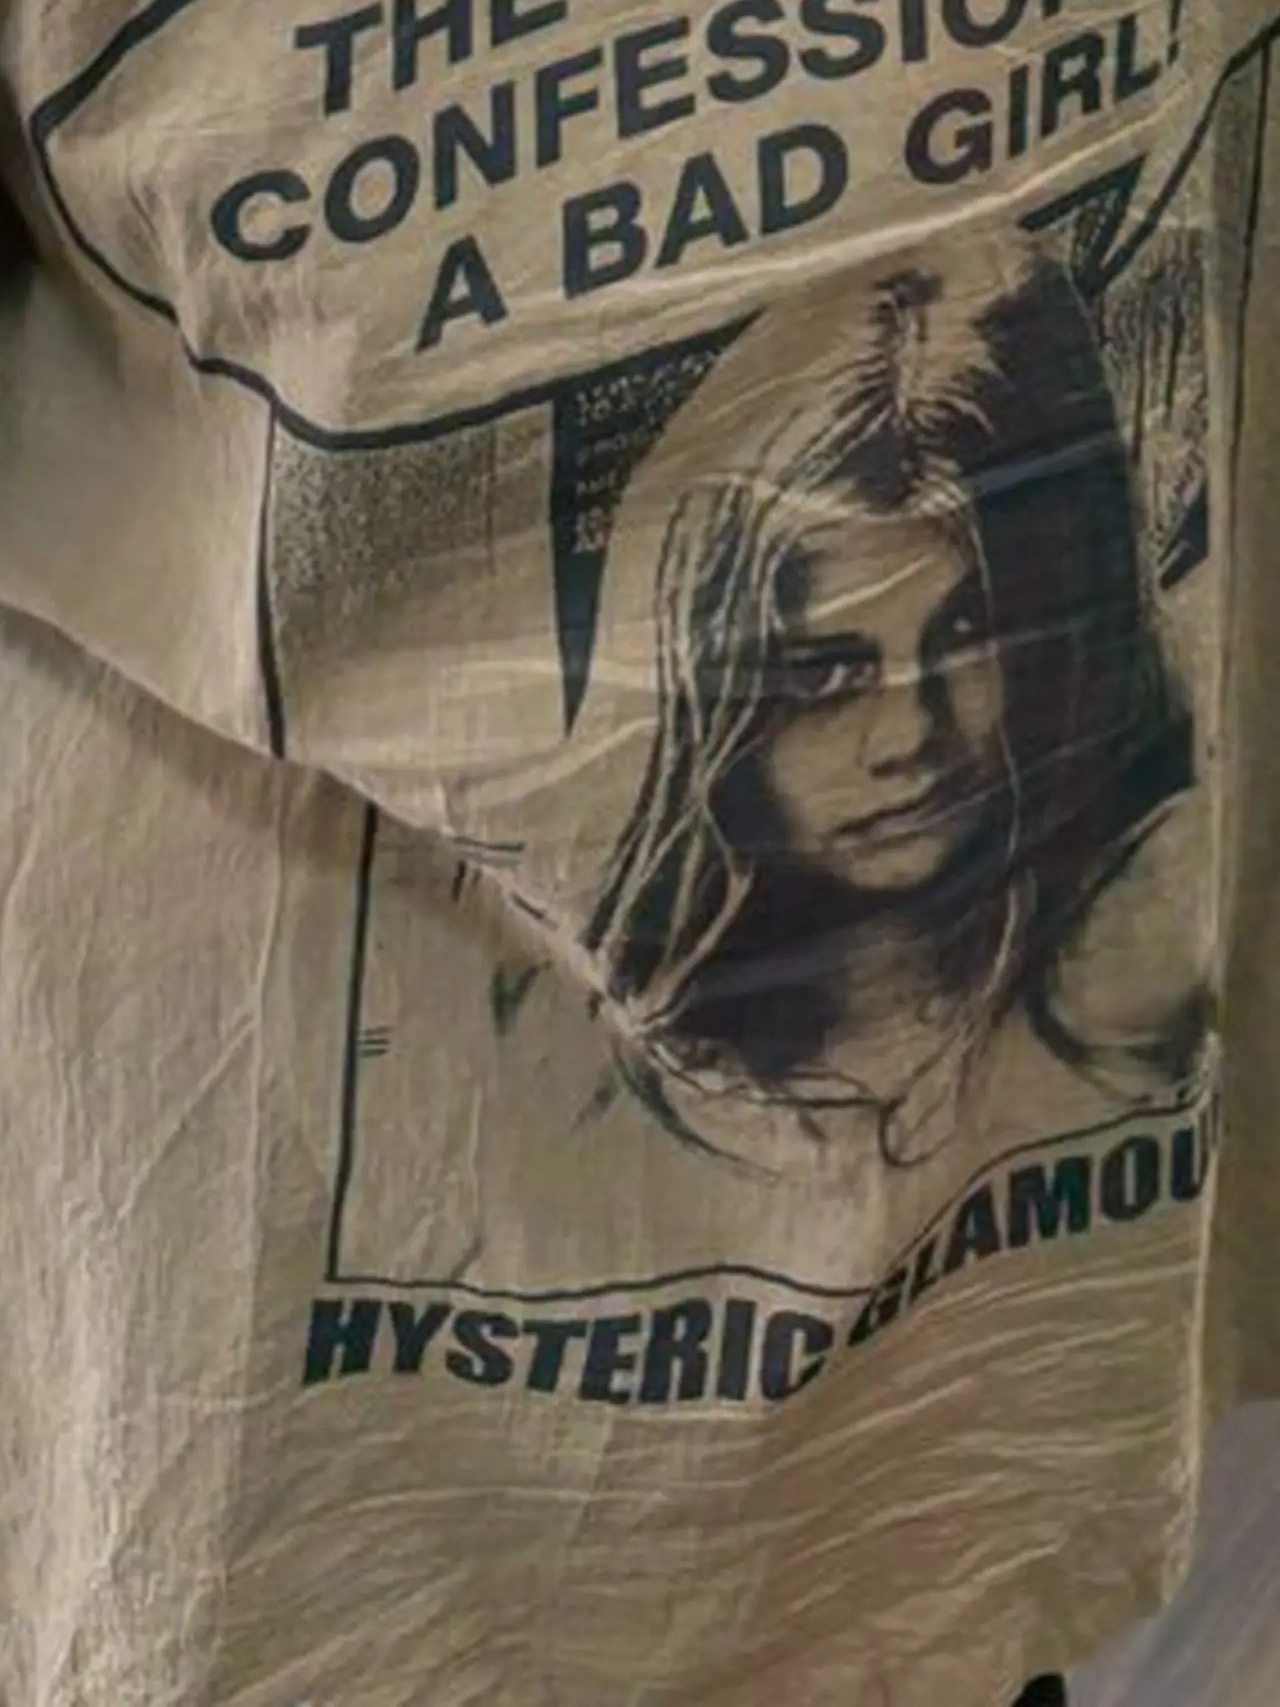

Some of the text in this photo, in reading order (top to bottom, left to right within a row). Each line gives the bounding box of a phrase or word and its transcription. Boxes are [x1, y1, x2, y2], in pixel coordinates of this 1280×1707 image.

[415, 235, 507, 354] A
[561, 121, 851, 300] BAD
[301, 1293, 836, 1407] HYSTERIC
